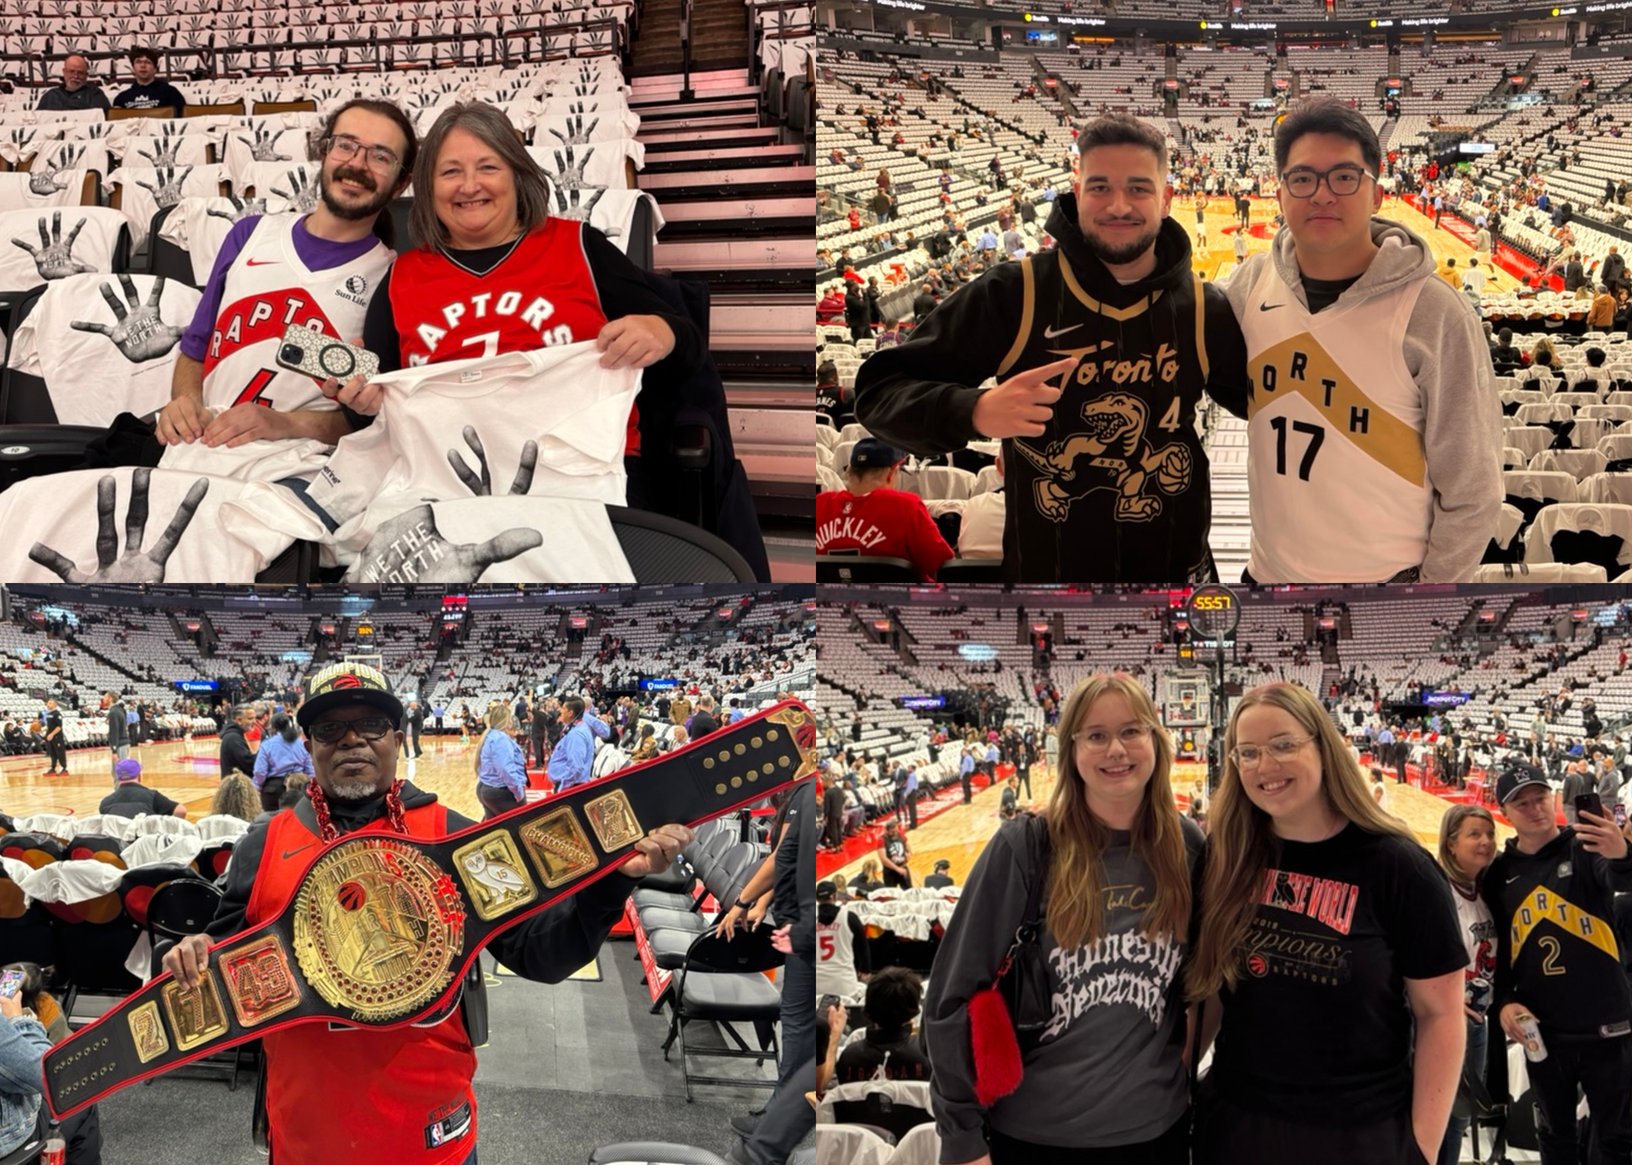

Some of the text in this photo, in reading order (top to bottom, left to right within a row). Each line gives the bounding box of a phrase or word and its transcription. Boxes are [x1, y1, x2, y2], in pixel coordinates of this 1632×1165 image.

[335, 289, 368, 307] Sun Life
[125, 323, 162, 349] NORTH
[210, 297, 326, 358] RAPTO
[1045, 340, 1180, 396] Toronto
[1157, 395, 1181, 433] 4
[1246, 351, 1370, 435] ORTH
[1270, 416, 1325, 482] 17
[365, 521, 433, 583] WE THE
[382, 540, 444, 583] ORTH
[1196, 596, 1231, 610] 55:57
[495, 869, 508, 881] 15
[818, 934, 837, 962] 5
[1538, 935, 1567, 976] 2
[237, 952, 291, 1006] 43
